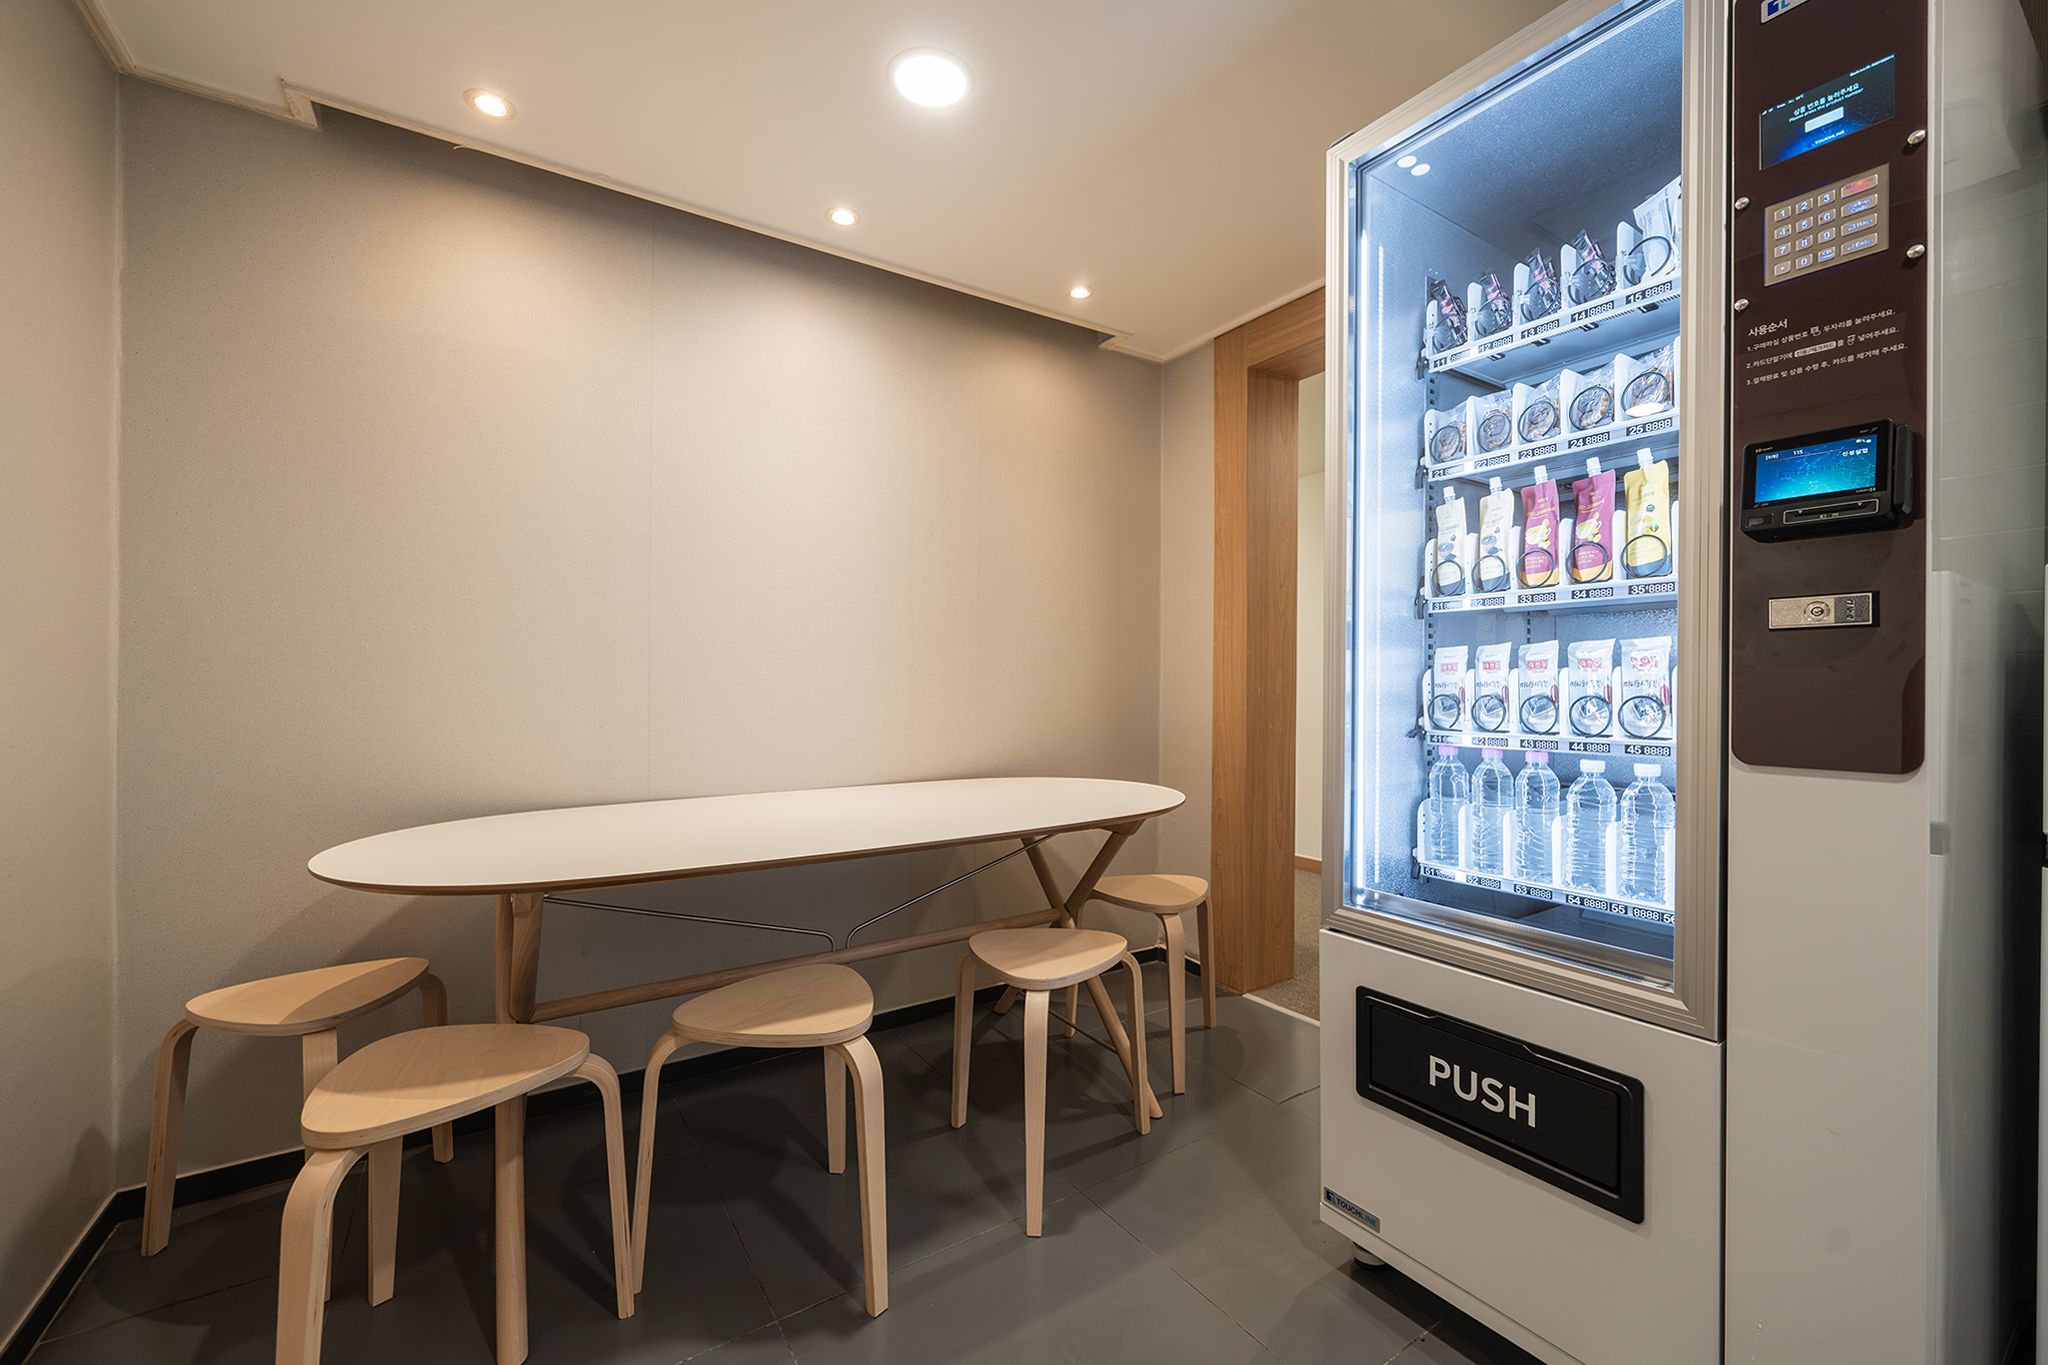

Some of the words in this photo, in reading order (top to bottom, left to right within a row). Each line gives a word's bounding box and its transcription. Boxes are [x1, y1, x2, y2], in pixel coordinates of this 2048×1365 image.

[1793, 106, 1806, 116] 상품
[1628, 292, 1642, 303] 15
[1645, 282, 1671, 298] 8888
[1573, 310, 1587, 321] 14
[1590, 301, 1613, 316] 8888
[1522, 329, 1535, 339] 13
[1537, 320, 1559, 333] 8888
[1748, 318, 1788, 336] 사용순서
[1780, 331, 1808, 344] 상품번호
[1480, 344, 1491, 353] 12
[1435, 357, 1447, 367] 11
[1789, 366, 1803, 376] 상품
[1629, 424, 1643, 435] 25
[1646, 419, 1672, 432] 8888
[1570, 439, 1584, 449] 24
[1586, 432, 1609, 445] 8888
[1520, 451, 1533, 460] 23
[1534, 444, 1556, 456] 8888
[1475, 459, 1488, 469] 22
[1489, 455, 1509, 466] 8888
[1433, 469, 1445, 478] 21
[1573, 589, 1587, 599] 34
[1589, 587, 1613, 598] 8888
[1631, 584, 1646, 594] 35
[1648, 582, 1674, 593] 8888
[1472, 599, 1484, 608] 32
[1519, 594, 1532, 604] 33
[1533, 592, 1555, 603] 8888
[1433, 602, 1443, 610] 31
[1473, 737, 1486, 746] 42
[1521, 740, 1535, 749] 43
[1536, 741, 1558, 749] 8888
[1571, 742, 1584, 751] 44
[1587, 743, 1609, 752] 8888
[1627, 744, 1642, 755] 45
[1644, 746, 1670, 756] 8888
[1425, 867, 1435, 875] 51
[1467, 876, 1479, 885] 52
[1480, 877, 1500, 889] 8888
[1515, 884, 1528, 895] 53
[1530, 888, 1552, 899] 8888
[1568, 895, 1581, 905] 54
[1583, 897, 1607, 910] 8888
[1611, 903, 1626, 914] 55
[1633, 908, 1660, 921] 8888
[1429, 1055, 1536, 1128] PUSH
[1336, 1198, 1377, 1227] TOUCHLINE
